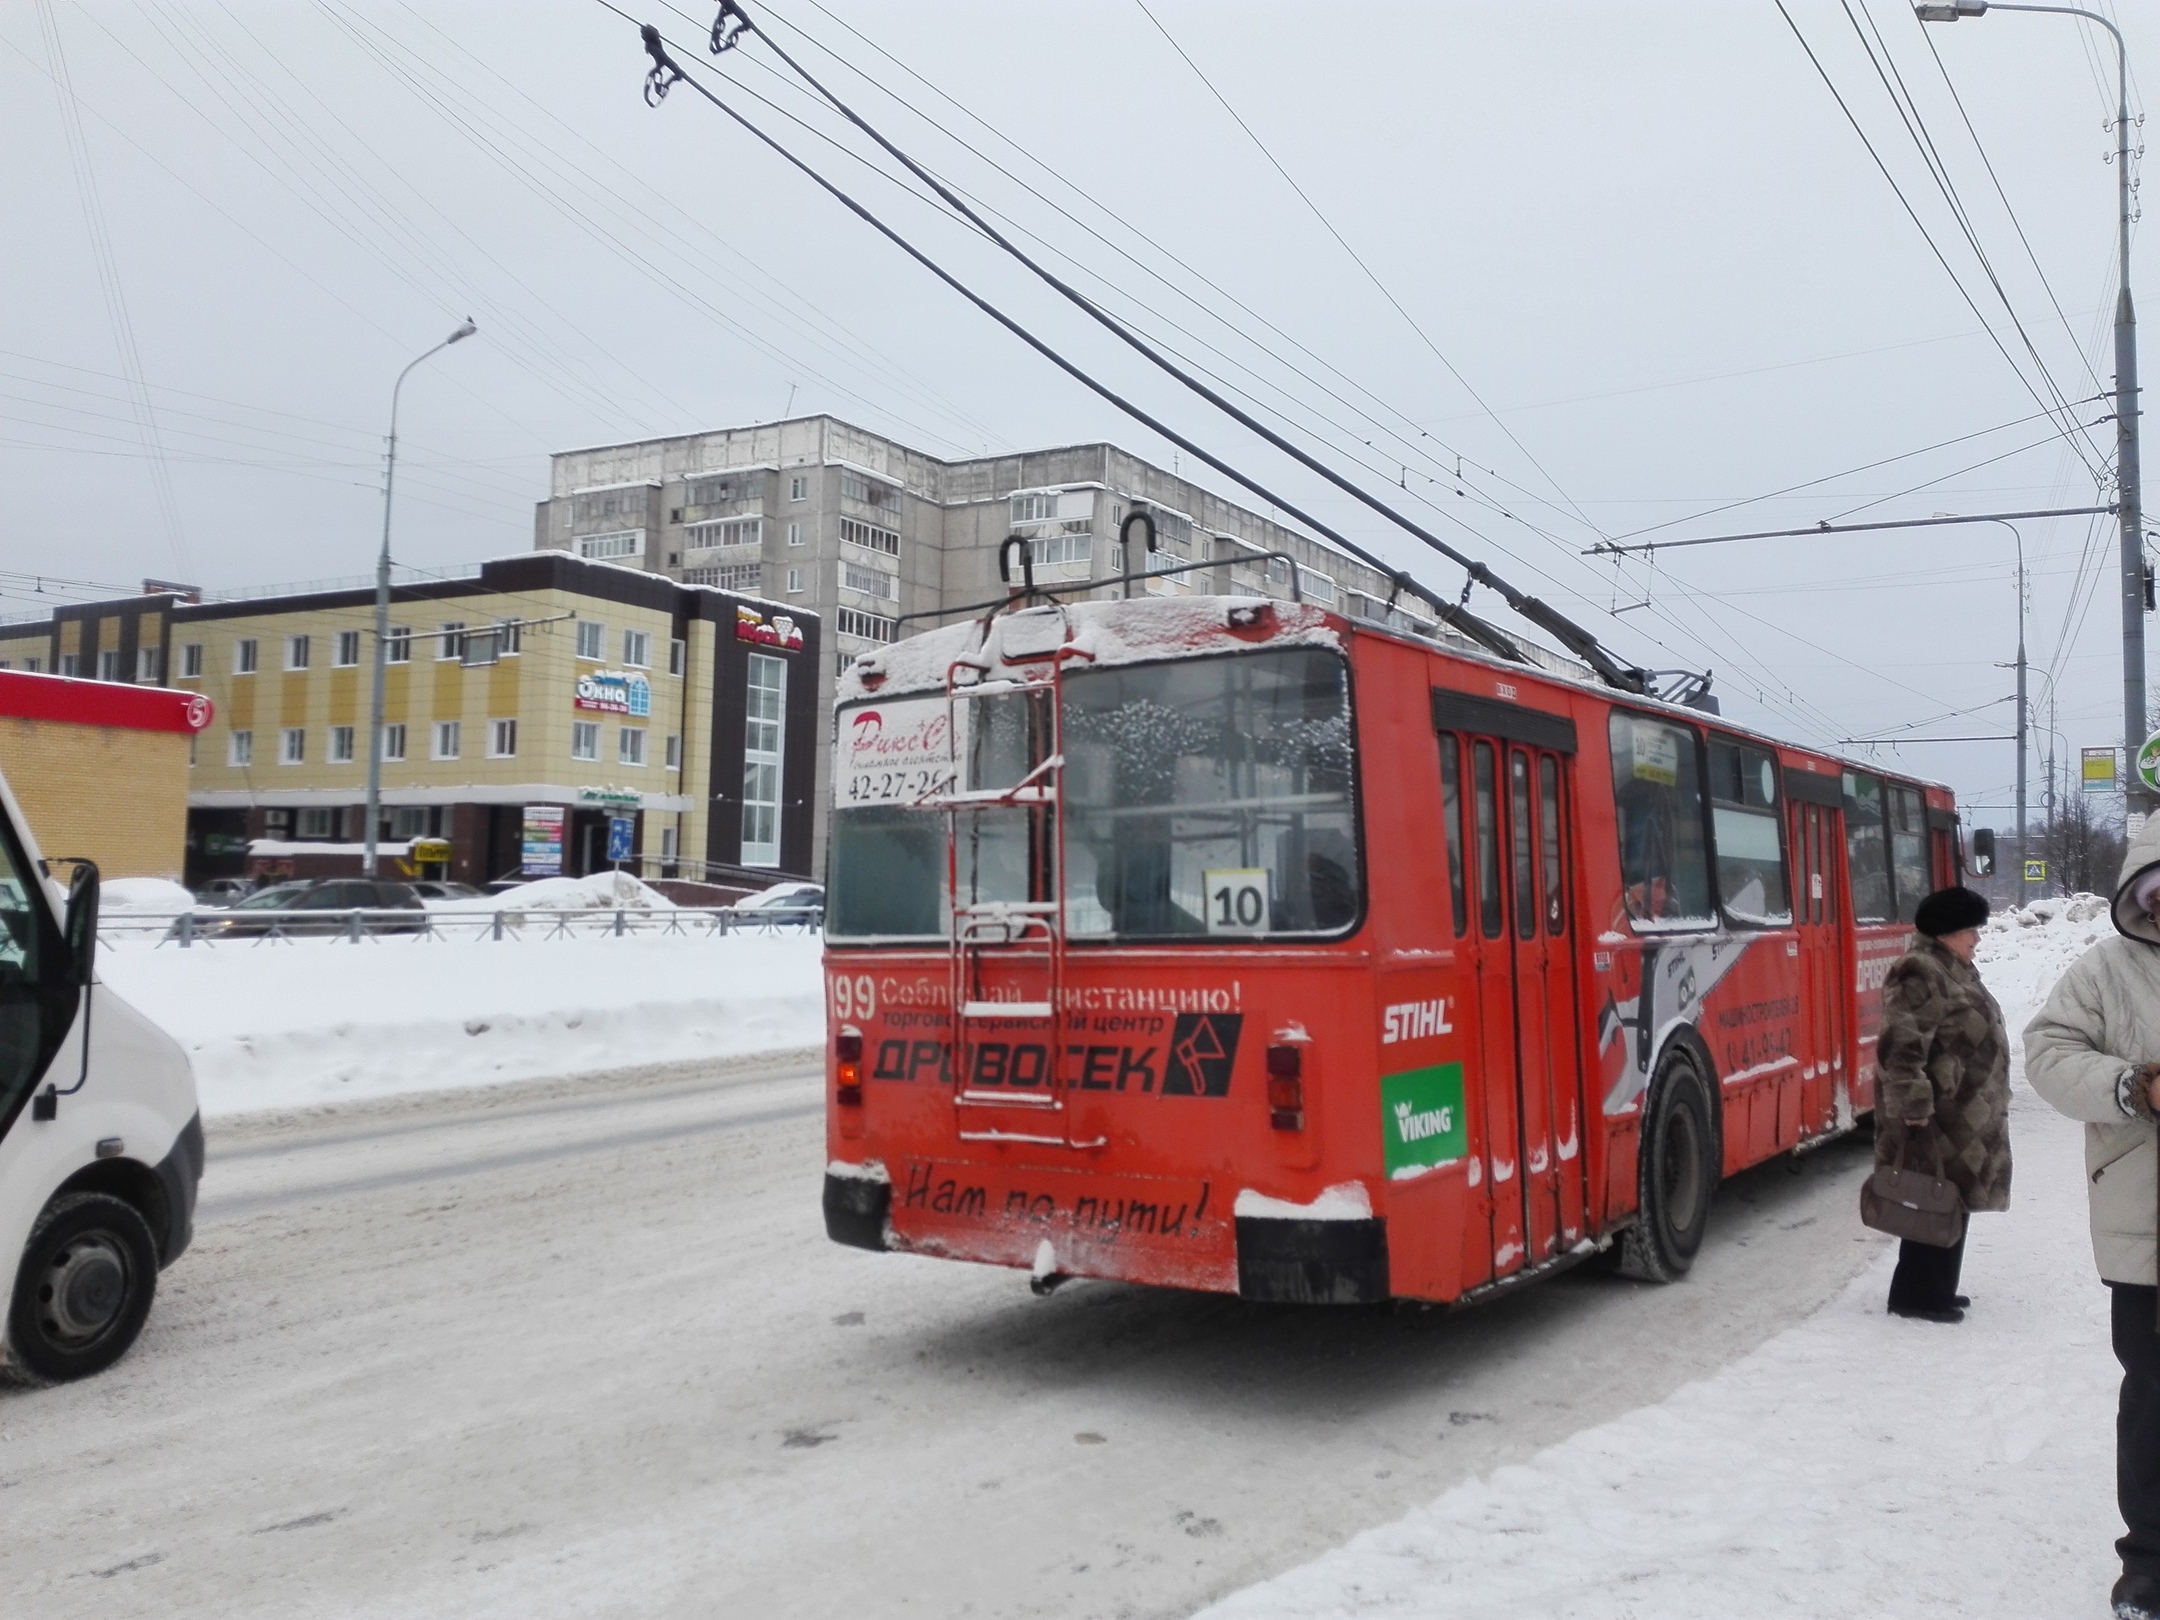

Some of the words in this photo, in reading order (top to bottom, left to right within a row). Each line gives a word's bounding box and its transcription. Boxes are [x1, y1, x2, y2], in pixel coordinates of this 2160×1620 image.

[1214, 886, 1263, 926] 10
[829, 974, 876, 1020] 199
[881, 977, 1021, 1006] Соблай
[1093, 1015, 1164, 1035] центр
[1383, 1000, 1453, 1044] STIHL
[1400, 1106, 1452, 1143] VIKING
[905, 1164, 986, 1216] Нам
[1004, 1190, 1055, 1222] по
[1074, 1181, 1209, 1243] пути!
